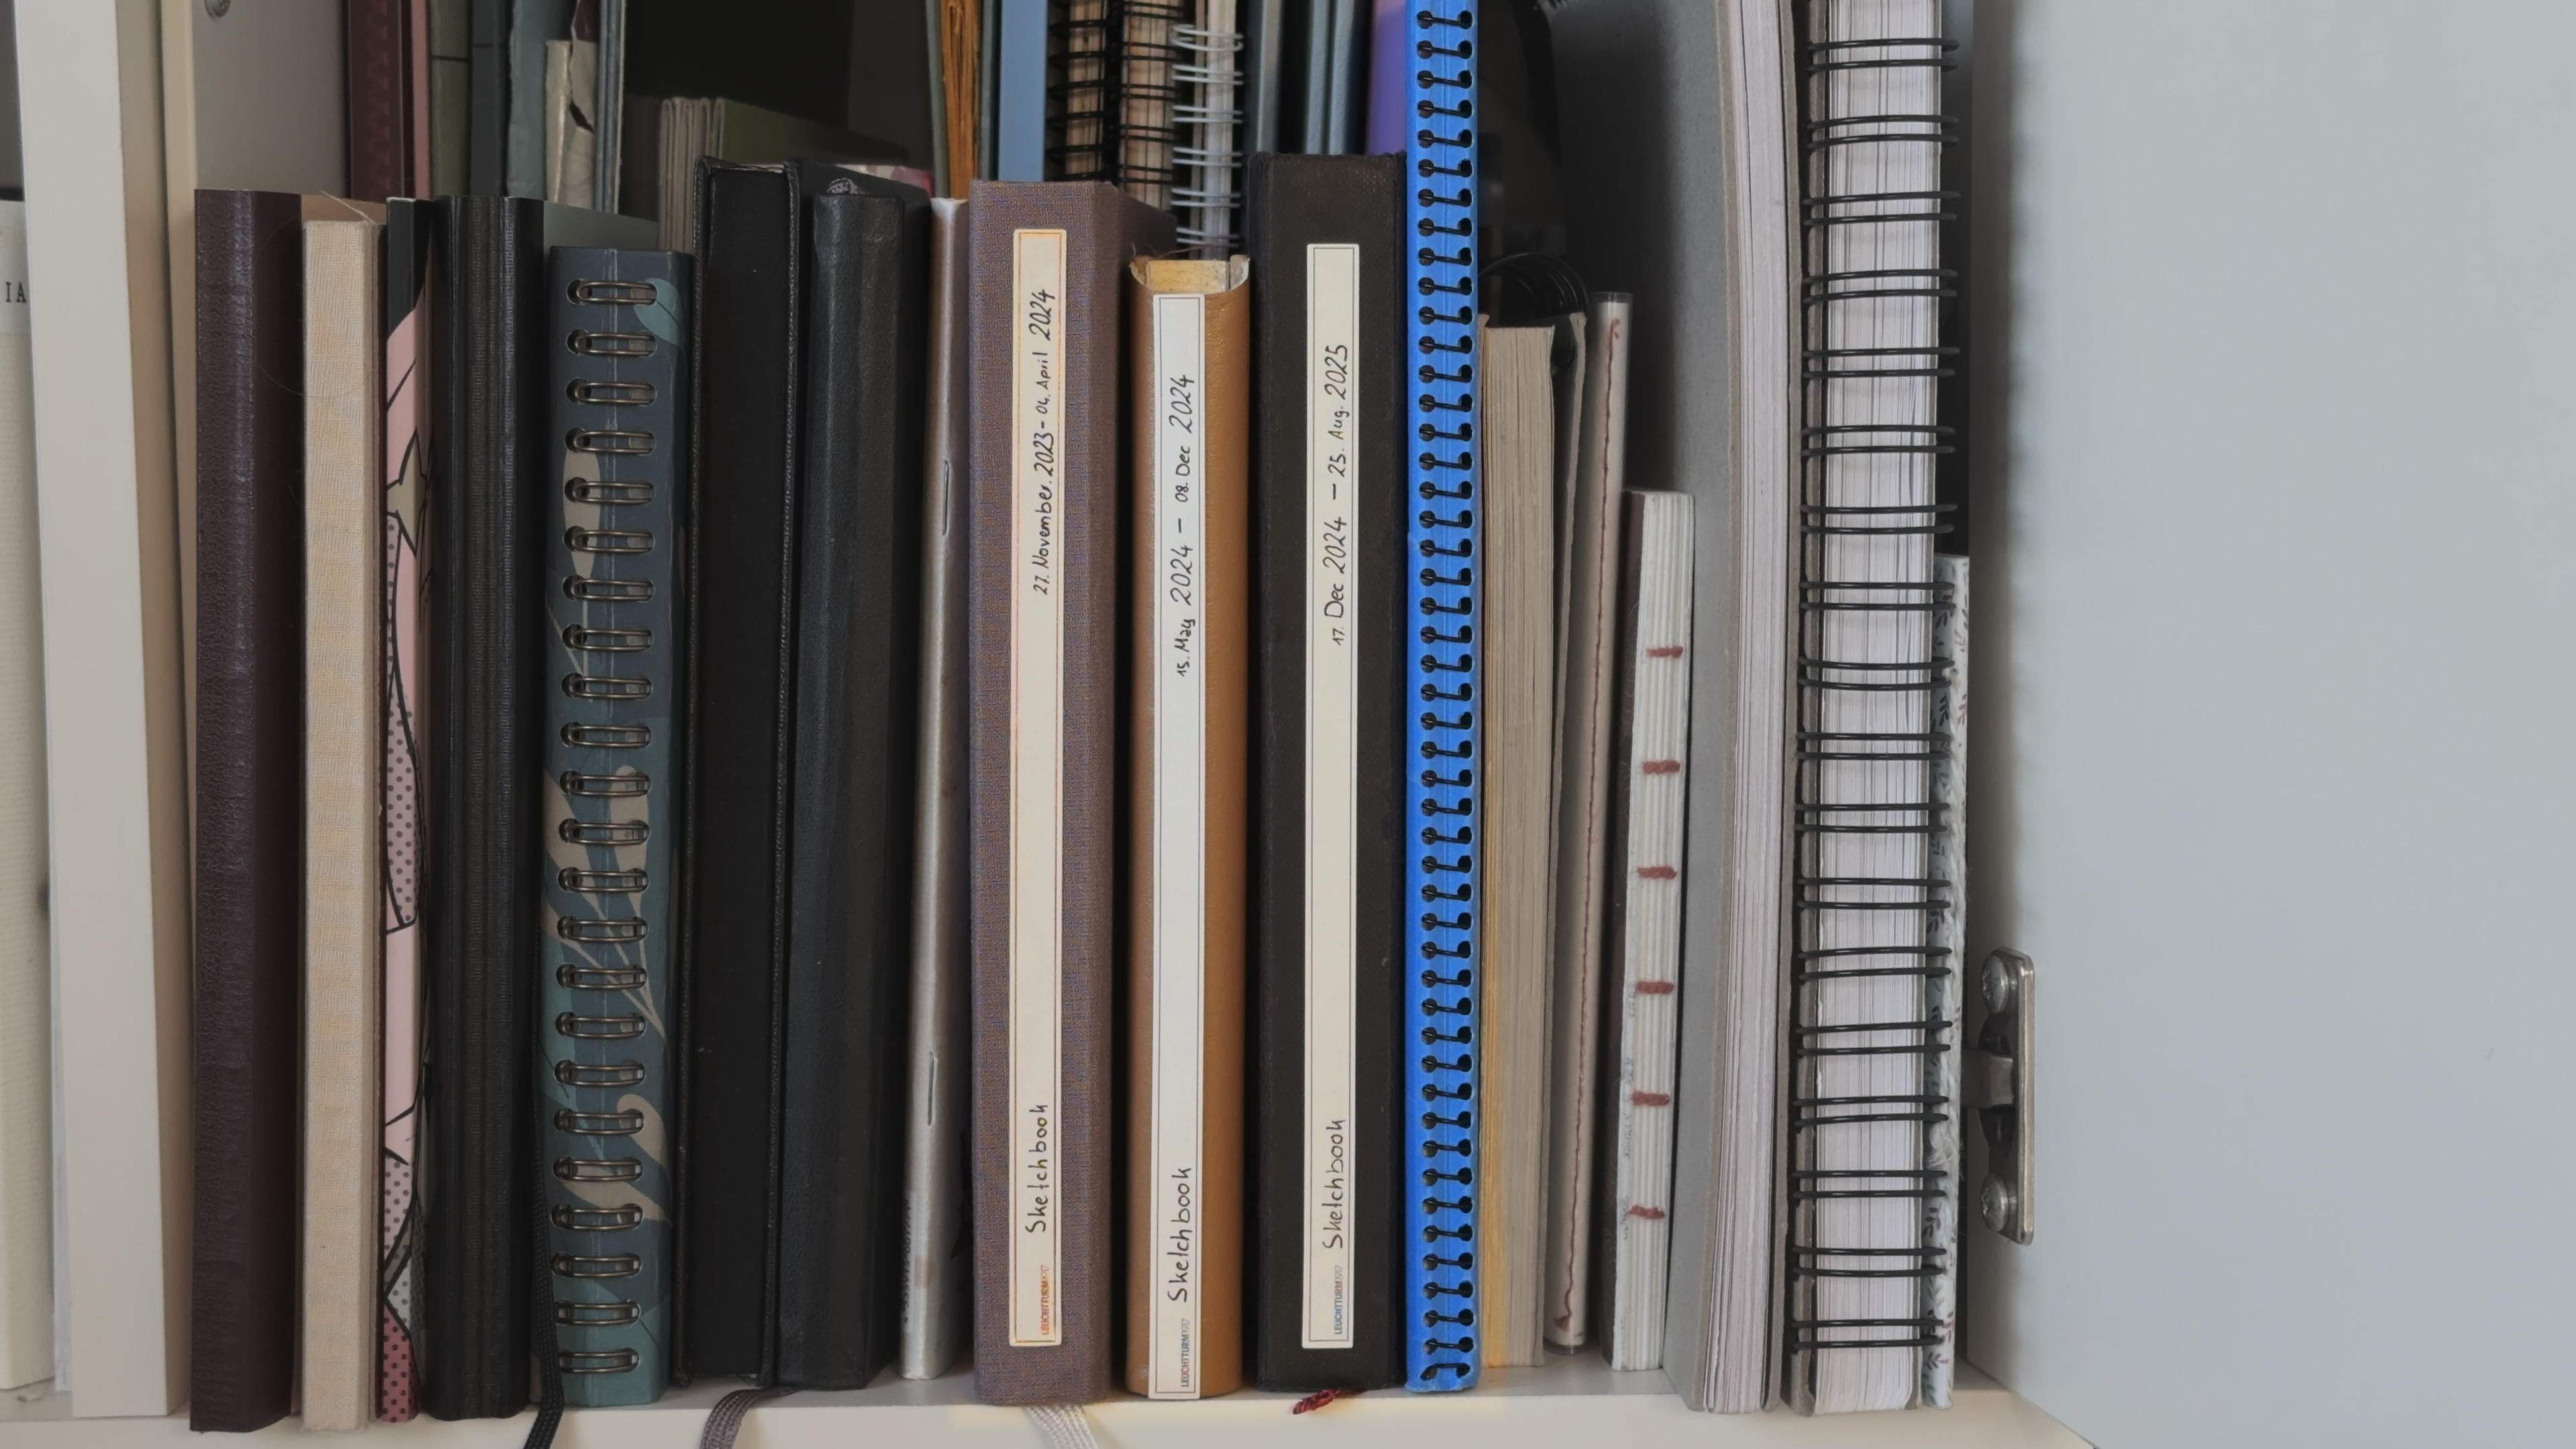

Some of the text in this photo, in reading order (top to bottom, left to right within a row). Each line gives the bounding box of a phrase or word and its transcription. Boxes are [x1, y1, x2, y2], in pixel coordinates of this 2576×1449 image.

[1028, 288, 1056, 341] 2024
[1032, 352, 1051, 390] April
[1324, 344, 1348, 400] 2025
[1168, 374, 1195, 434] 2024
[1327, 406, 1350, 440] Aug.
[1175, 445, 1191, 477] Dec
[1327, 448, 1346, 478] 25.
[1322, 516, 1348, 575] 2024
[1169, 544, 1193, 606] 2024
[1324, 583, 1344, 619] Dec
[1173, 619, 1196, 653] May
[1024, 1105, 1050, 1234] Sketchbook
[1321, 1120, 1346, 1249] Sketchbook
[1166, 1167, 1193, 1303] Sketchbook
[1334, 1265, 1343, 1335] LEUCHTTURM1917
[1180, 1318, 1190, 1387] LEUCHTTURM1917
